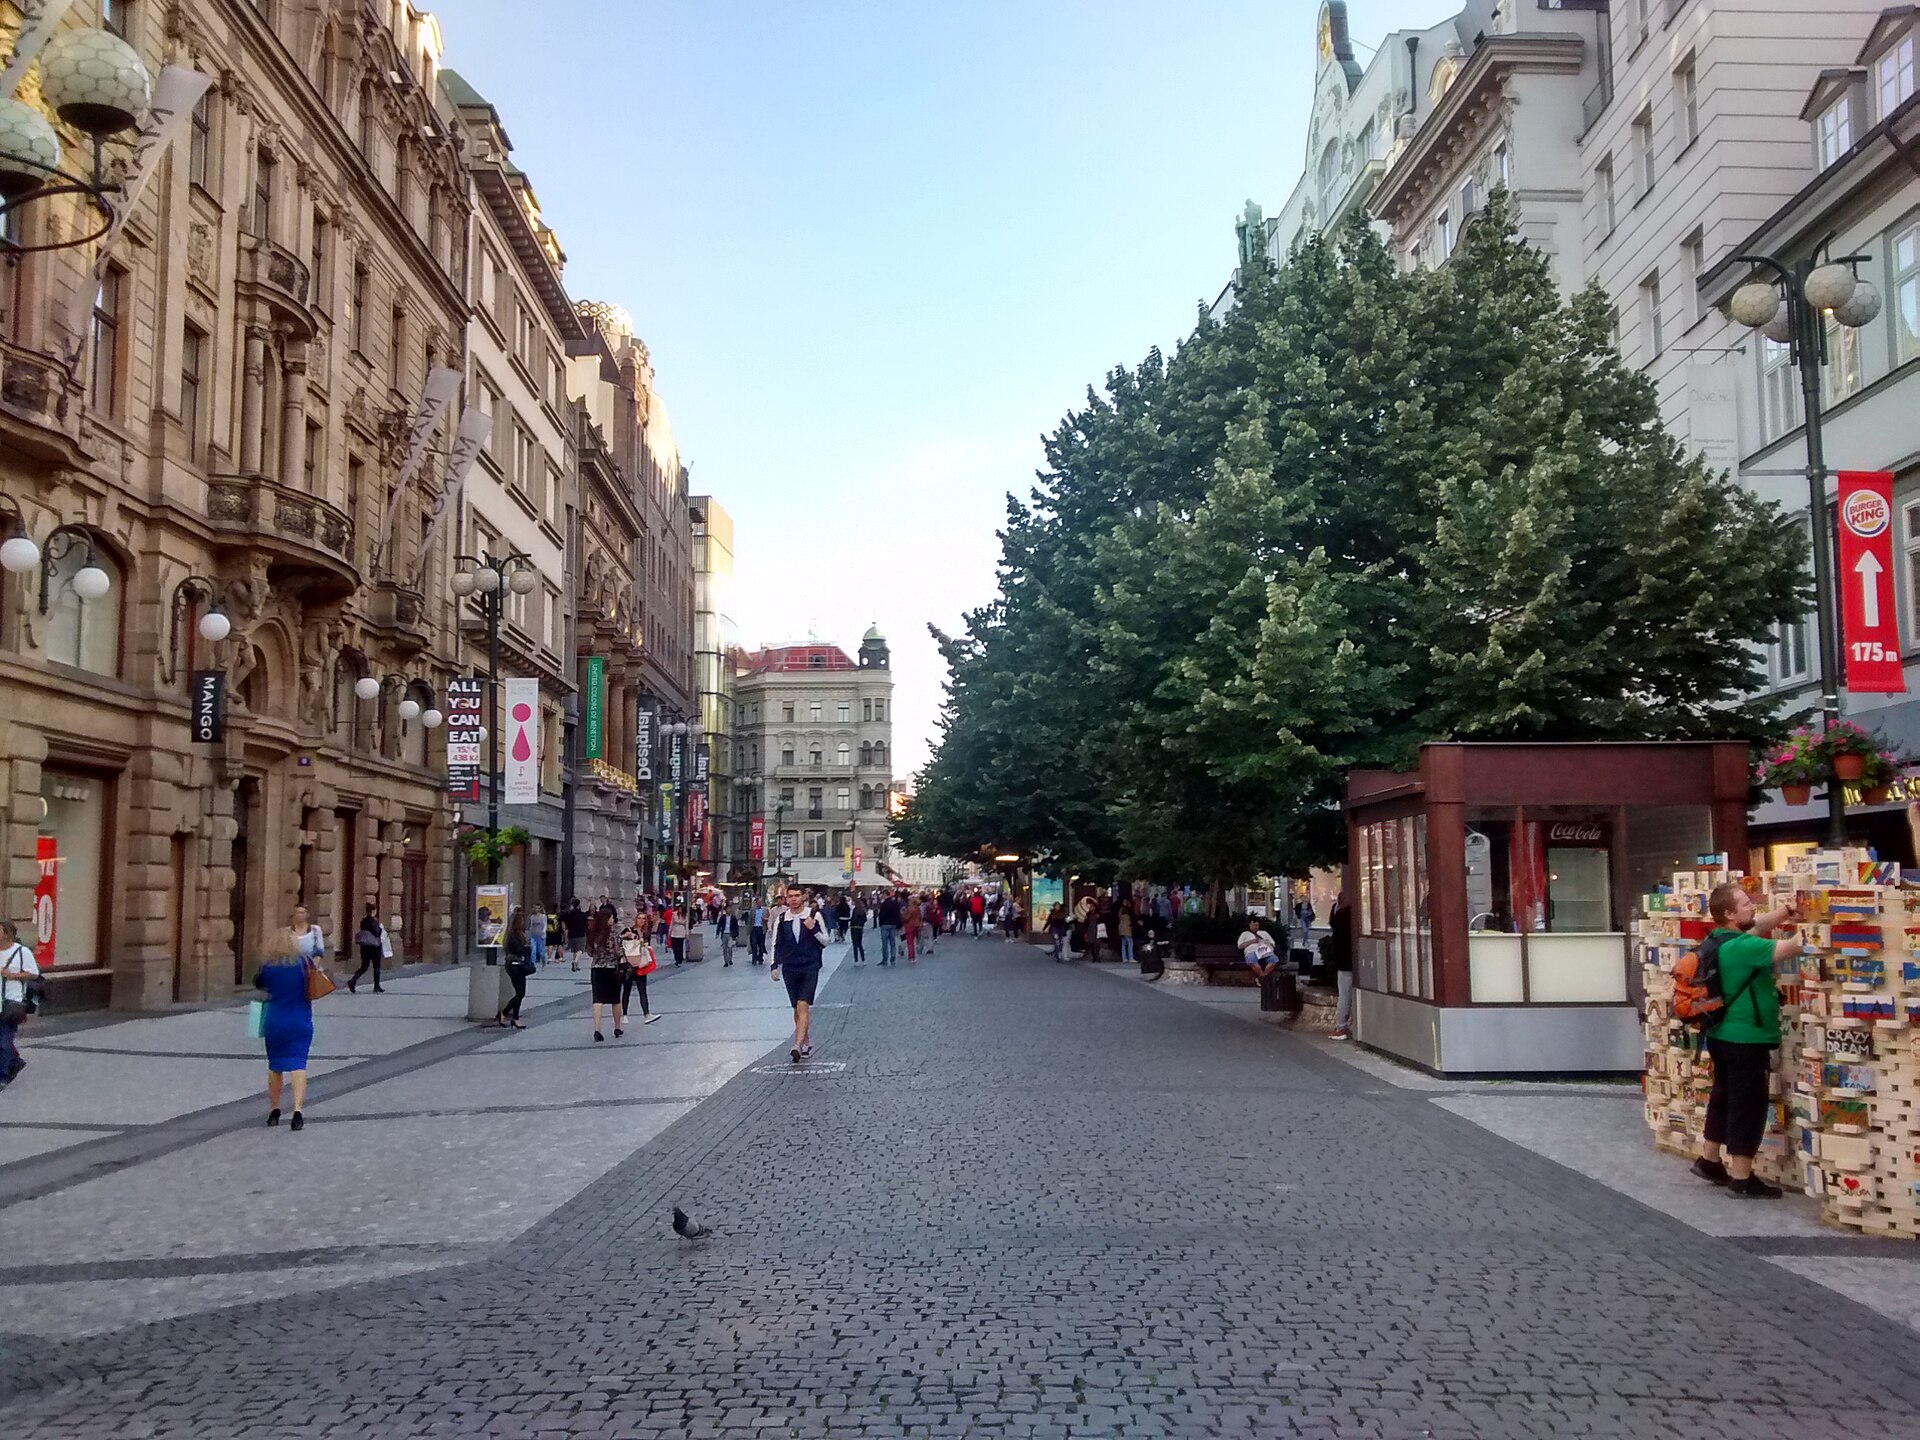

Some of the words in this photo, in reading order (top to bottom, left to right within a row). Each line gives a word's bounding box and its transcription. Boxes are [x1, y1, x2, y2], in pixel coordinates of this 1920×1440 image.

[1849, 498, 1883, 515] BURGER
[1851, 507, 1884, 526] KING
[448, 681, 481, 692] ALL
[199, 676, 216, 740] MANGO
[448, 714, 480, 726] CAN
[449, 731, 480, 742] EAT
[636, 710, 652, 780] Desigual
[1826, 1029, 1870, 1044] CRAZY
[1826, 1041, 1870, 1056] DREAM
[1828, 1171, 1841, 1187] I
